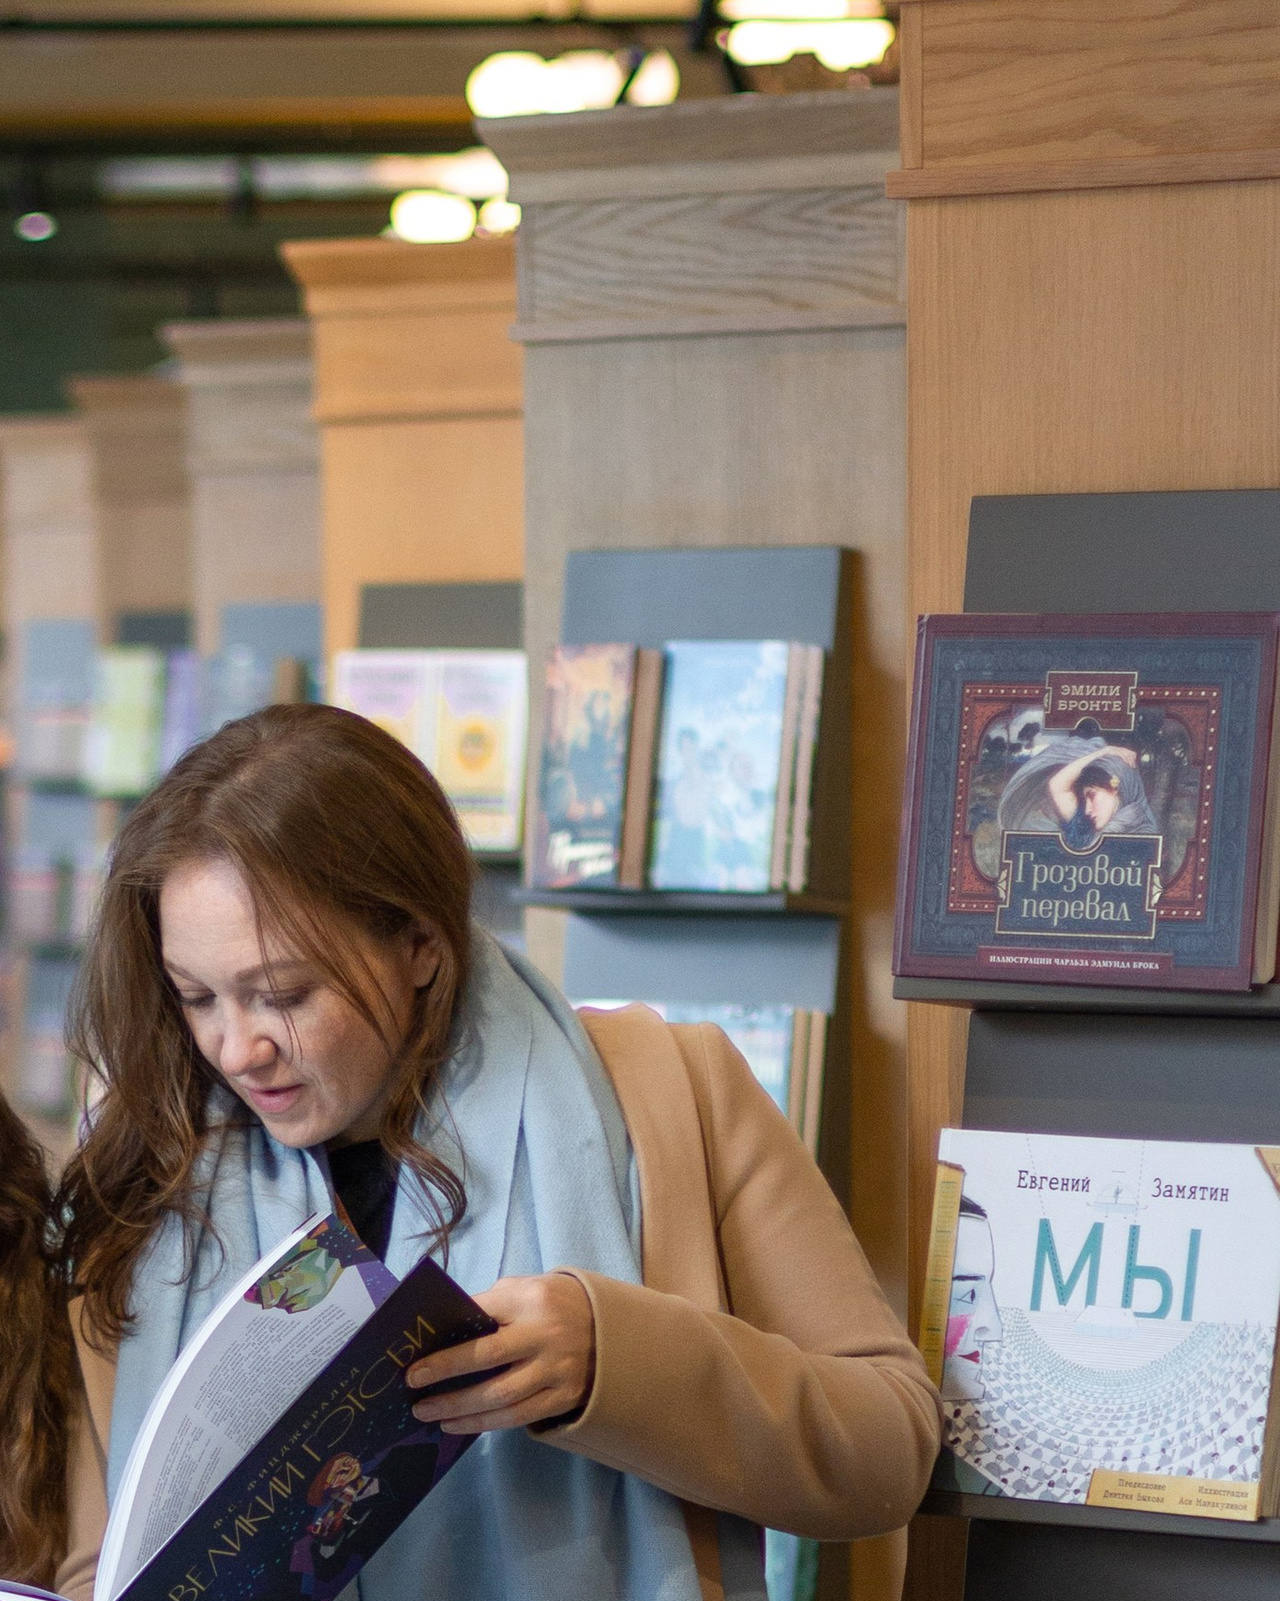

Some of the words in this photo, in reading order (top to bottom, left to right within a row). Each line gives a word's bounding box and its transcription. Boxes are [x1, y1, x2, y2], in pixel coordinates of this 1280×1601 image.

[1057, 700, 1122, 712] БРОНТЕ
[1060, 685, 1120, 697] ЭМИЛИ
[1015, 851, 1142, 891] Грозовой
[1022, 889, 1131, 925] перевал
[989, 955, 1052, 965] ИЛЛЮСТРАЦИИ
[1054, 958, 1089, 967] ЧАРЛЬЗА
[1091, 960, 1130, 969] ЭДМУНДА
[1132, 961, 1159, 970] БРОКА
[1017, 1169, 1091, 1193] Евгений
[1151, 1177, 1230, 1202] Замятин
[1029, 1217, 1202, 1322] МЫ
[301, 1315, 436, 1462] ГЭТСБИ
[247, 1367, 360, 1491] ФИЦДЖЕРАЛЬД
[1118, 1478, 1167, 1491] Предисловие
[1198, 1485, 1249, 1499] Иллюстрации
